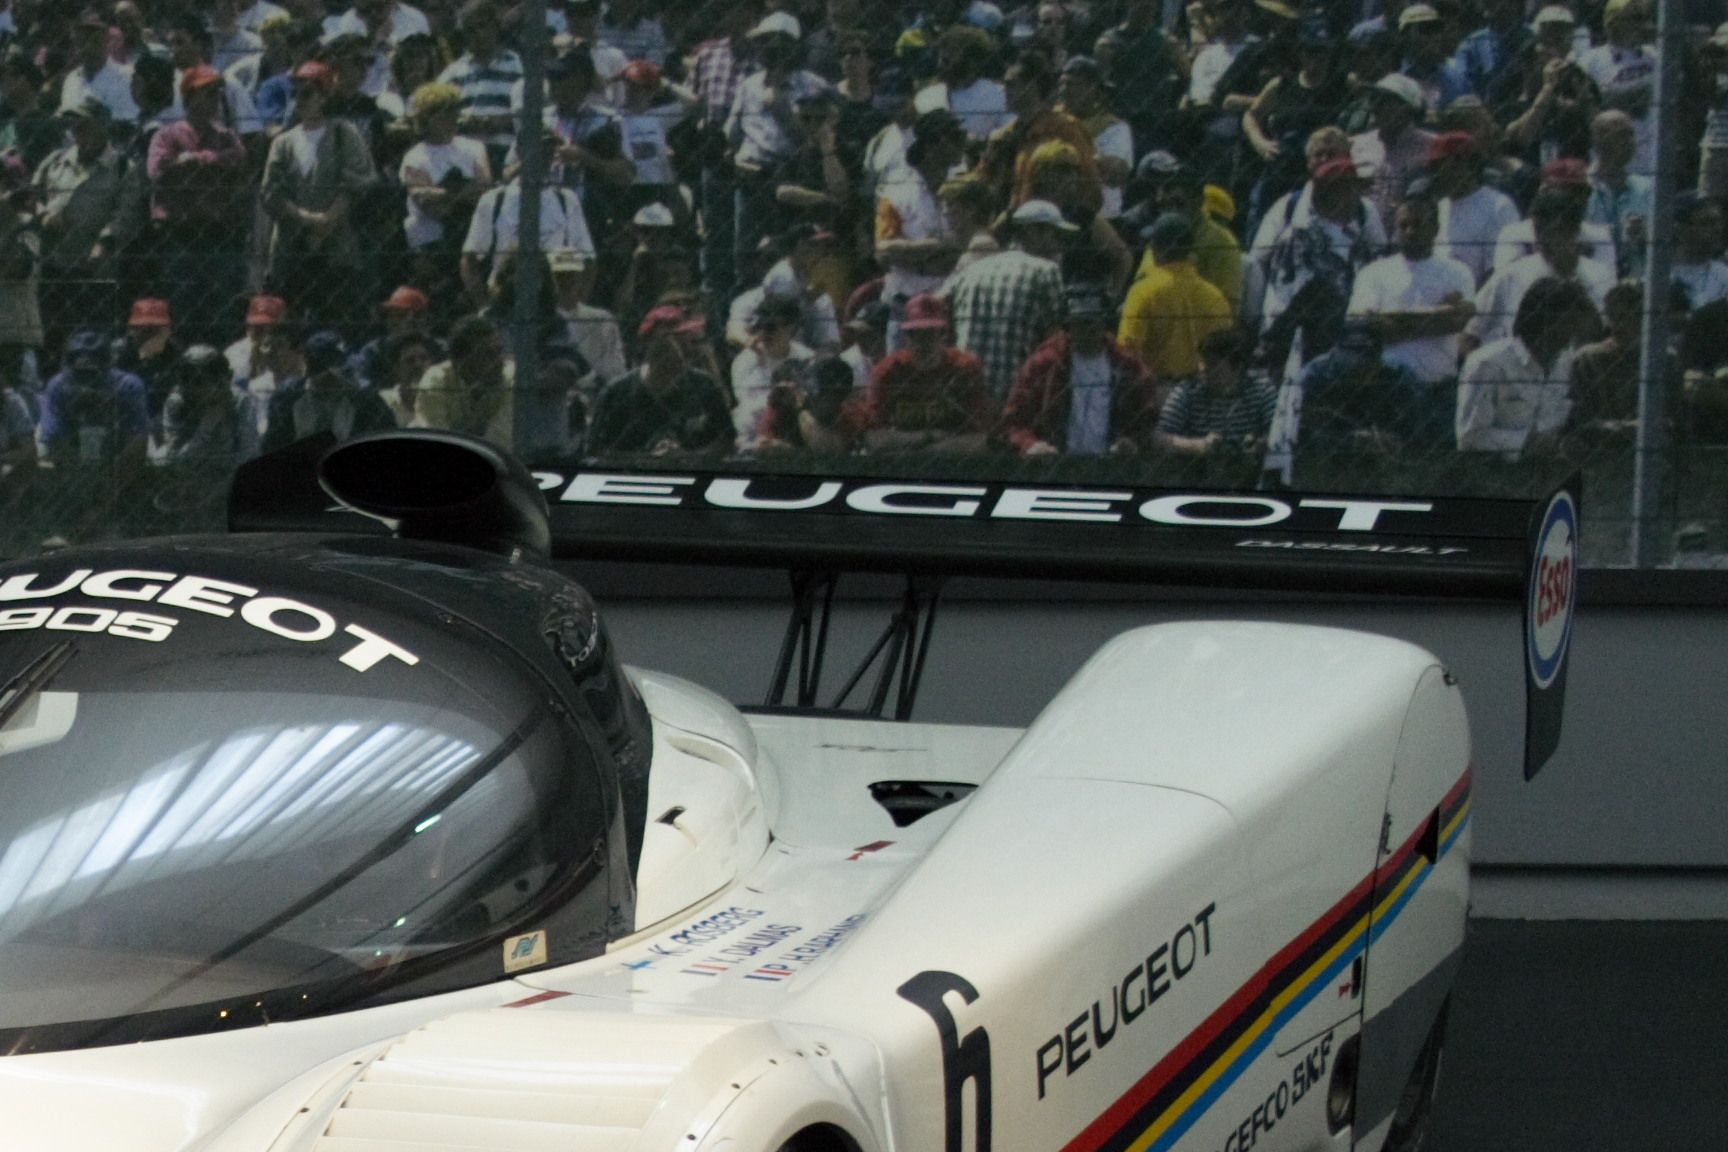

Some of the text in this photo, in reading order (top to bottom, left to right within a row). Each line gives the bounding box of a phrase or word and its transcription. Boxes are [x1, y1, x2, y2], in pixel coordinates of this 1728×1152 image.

[1235, 540, 1468, 555] DASSAULT
[670, 907, 766, 946] ROSBERG
[720, 924, 802, 957] DALMAS
[1036, 902, 1216, 1101] PEUGEOT
[1291, 1031, 1335, 1107] SKF
